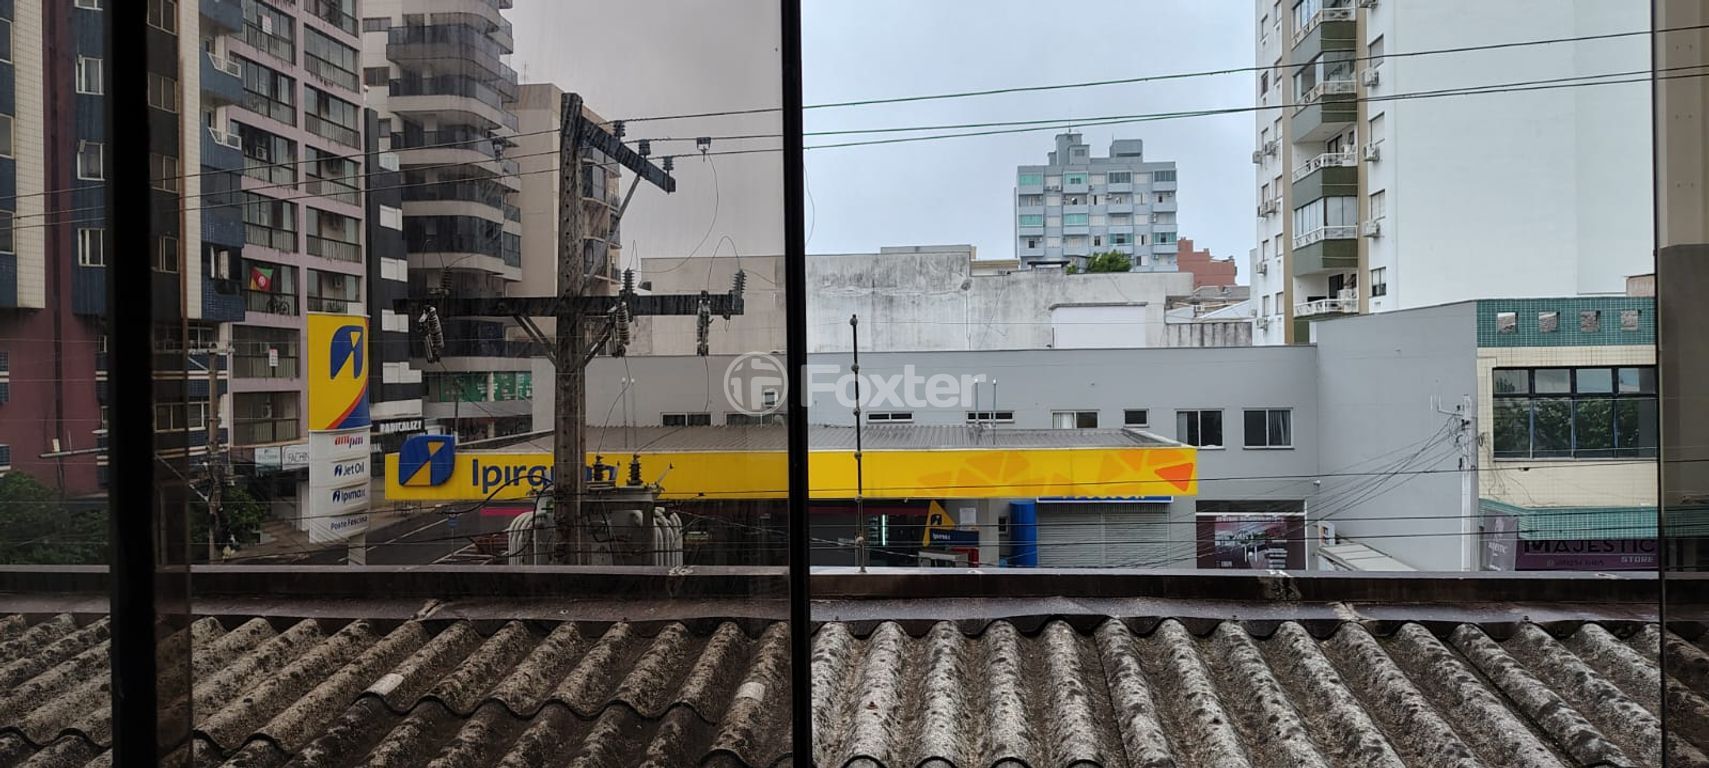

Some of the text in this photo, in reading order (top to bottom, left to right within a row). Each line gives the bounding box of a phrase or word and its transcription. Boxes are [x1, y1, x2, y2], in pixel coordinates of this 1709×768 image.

[335, 435, 364, 448] ampm
[343, 461, 365, 476] Jet Oil
[472, 458, 617, 494] Ipira
[1524, 540, 1655, 553] MAJESTIC
[1620, 555, 1654, 563] STORE
